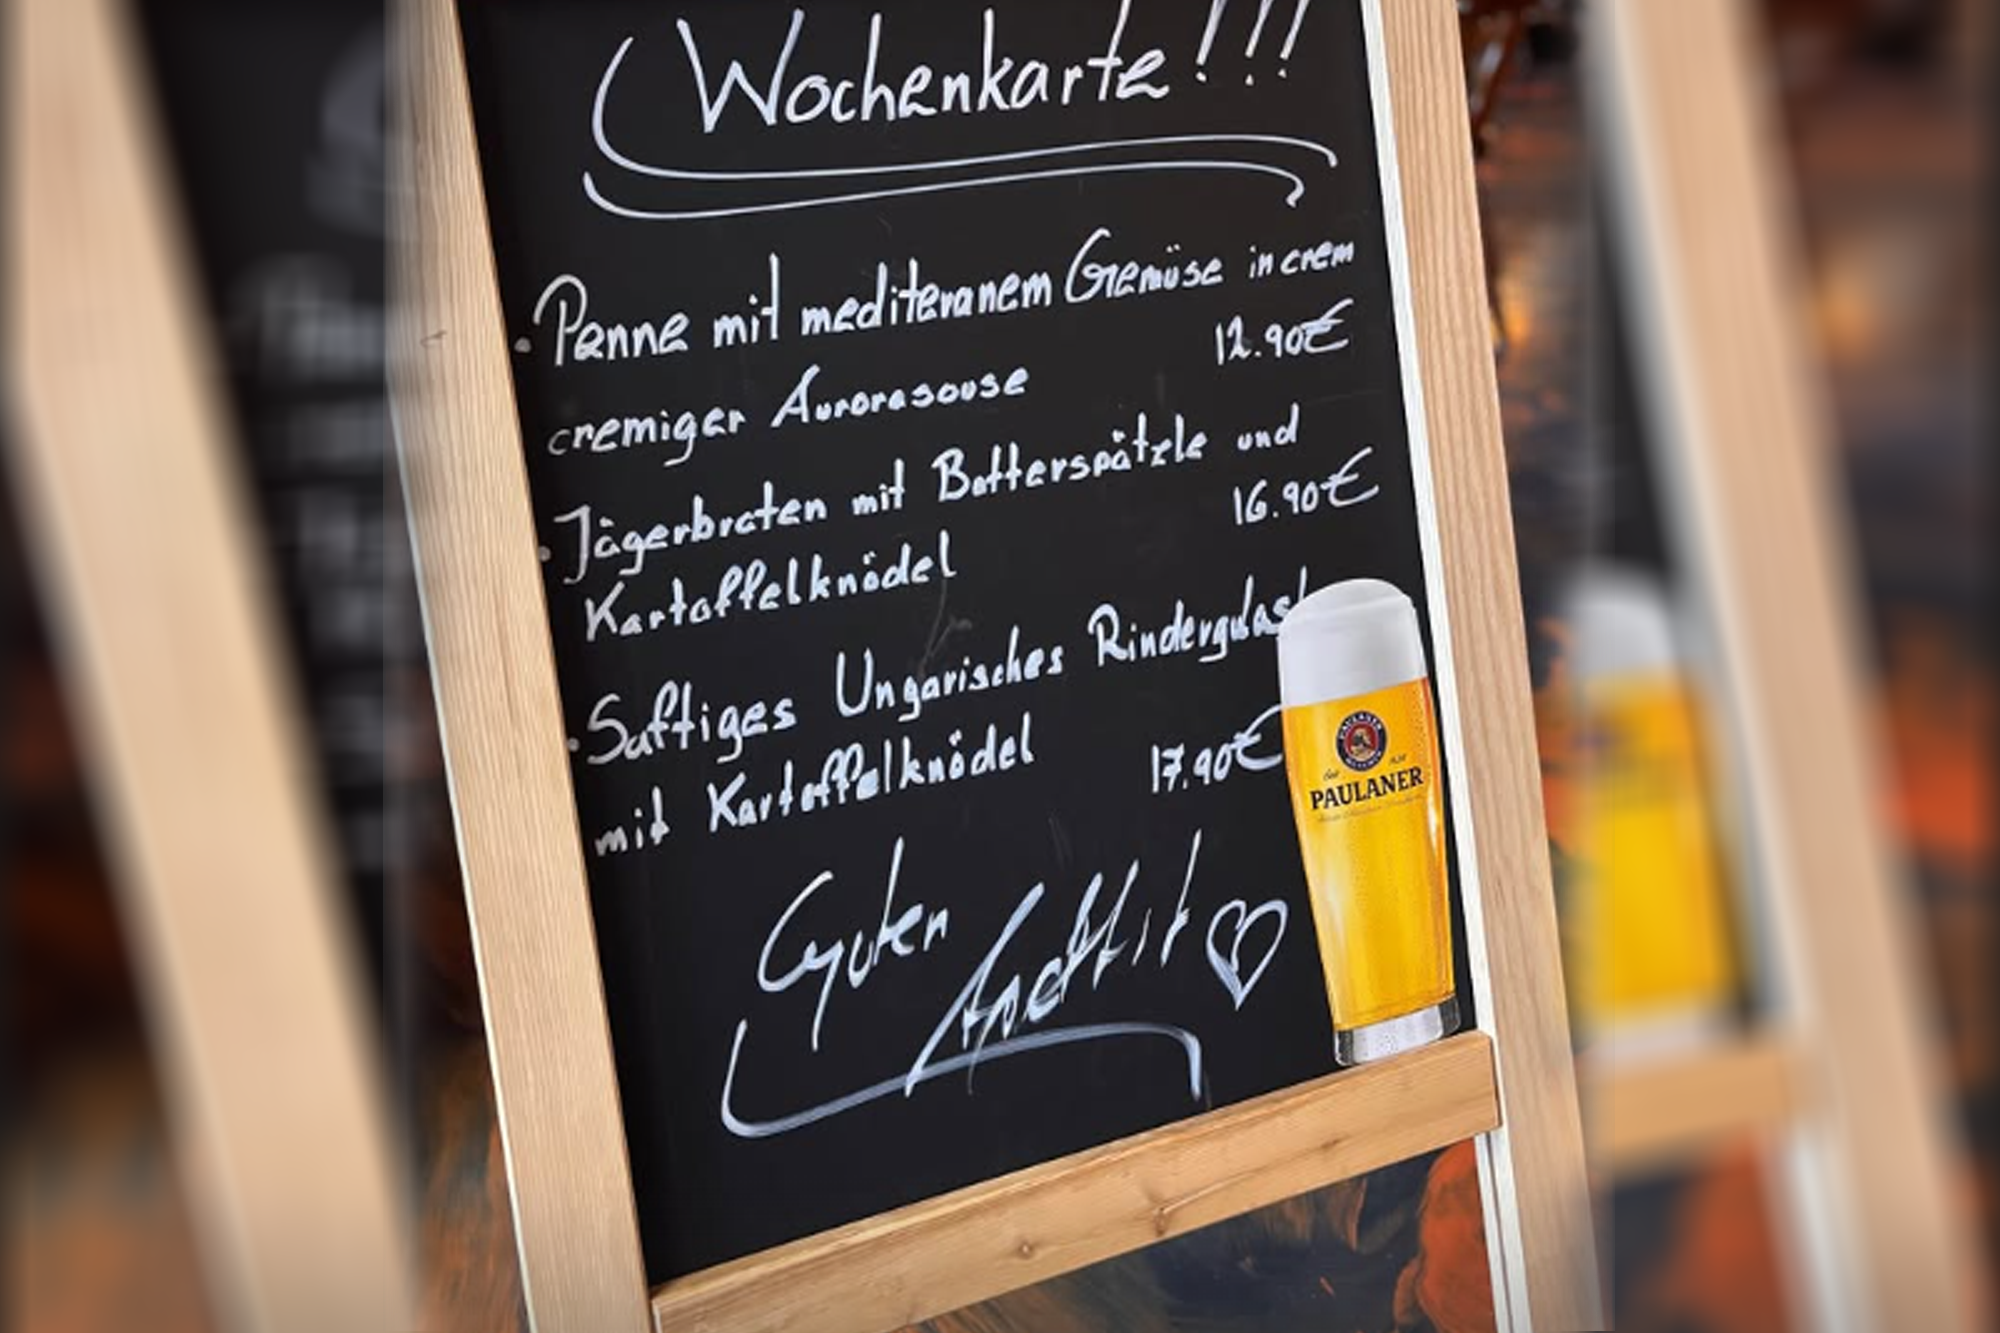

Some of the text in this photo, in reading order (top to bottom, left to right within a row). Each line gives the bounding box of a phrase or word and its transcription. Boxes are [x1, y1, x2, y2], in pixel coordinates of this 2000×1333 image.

[533, 274, 690, 366] Penne
[713, 252, 780, 348] mit
[1064, 228, 1223, 306] Gemüse
[1215, 298, 1354, 366] 12.90€
[548, 407, 747, 467] cremiger
[1233, 446, 1380, 526] 16.90€
[553, 481, 828, 585] Jägerbraten
[851, 458, 906, 515] mit
[1237, 402, 1300, 451] und
[584, 528, 958, 643] Kartoffelknödel
[587, 565, 1308, 766] Saftiges Ungarisches Rindergulas
[595, 711, 1035, 857] mit Kartoffelknödel
[1151, 703, 1283, 794] 17.90€
[1310, 767, 1423, 810] PAULANER
